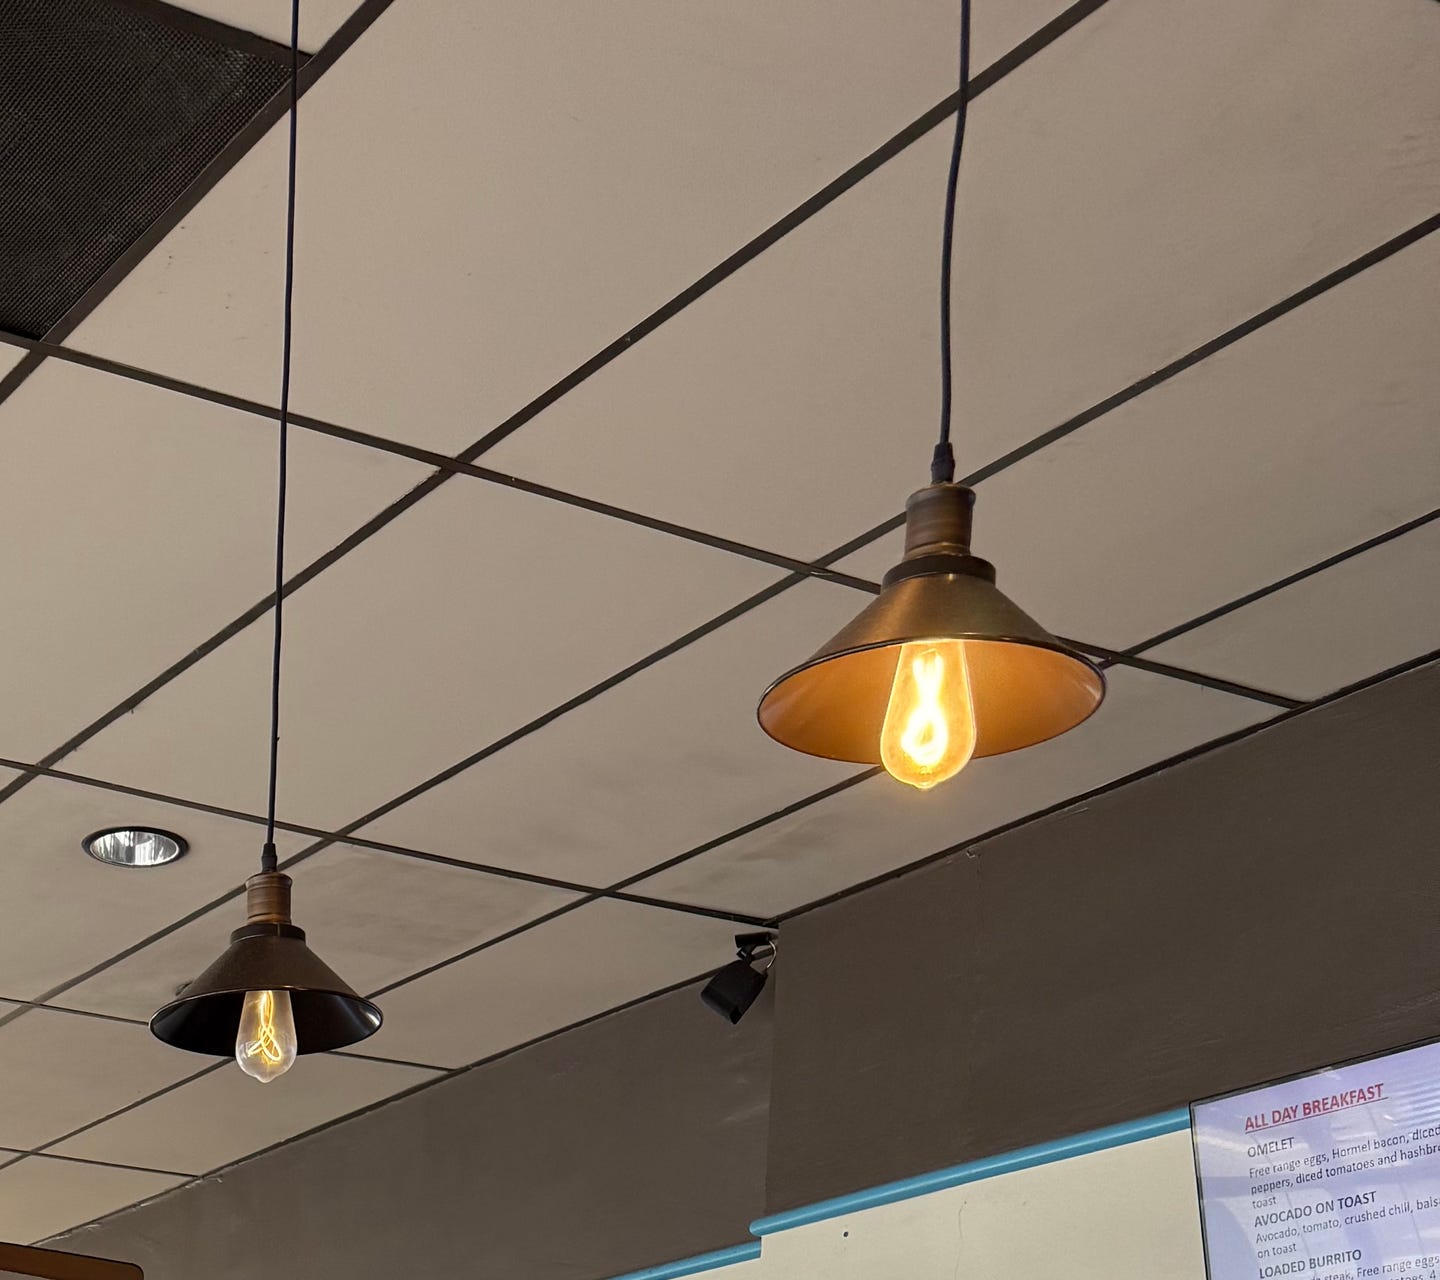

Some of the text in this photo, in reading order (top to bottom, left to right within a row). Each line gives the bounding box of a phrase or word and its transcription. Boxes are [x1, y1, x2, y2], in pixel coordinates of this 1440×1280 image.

[1246, 1084, 1384, 1130] ALL DAY BREAKFAST
[1248, 1137, 1294, 1158] OMELET
[1249, 1134, 1409, 1178] Free range eggs, Hormel bacon,
[1251, 1152, 1397, 1196] peppers, diced tomatoes and
[1252, 1196, 1276, 1209] toast
[1254, 1191, 1376, 1227] AVOCADO ON TOAST
[1256, 1208, 1386, 1243] Avocado, tomato, crushed
[1258, 1243, 1296, 1259] on toast
[1260, 1250, 1361, 1279] LOADED BURRITO
[1357, 1265, 1380, 1279] Free
[1382, 1259, 1411, 1276] range
[1430, 1270, 1436, 1280] 4
